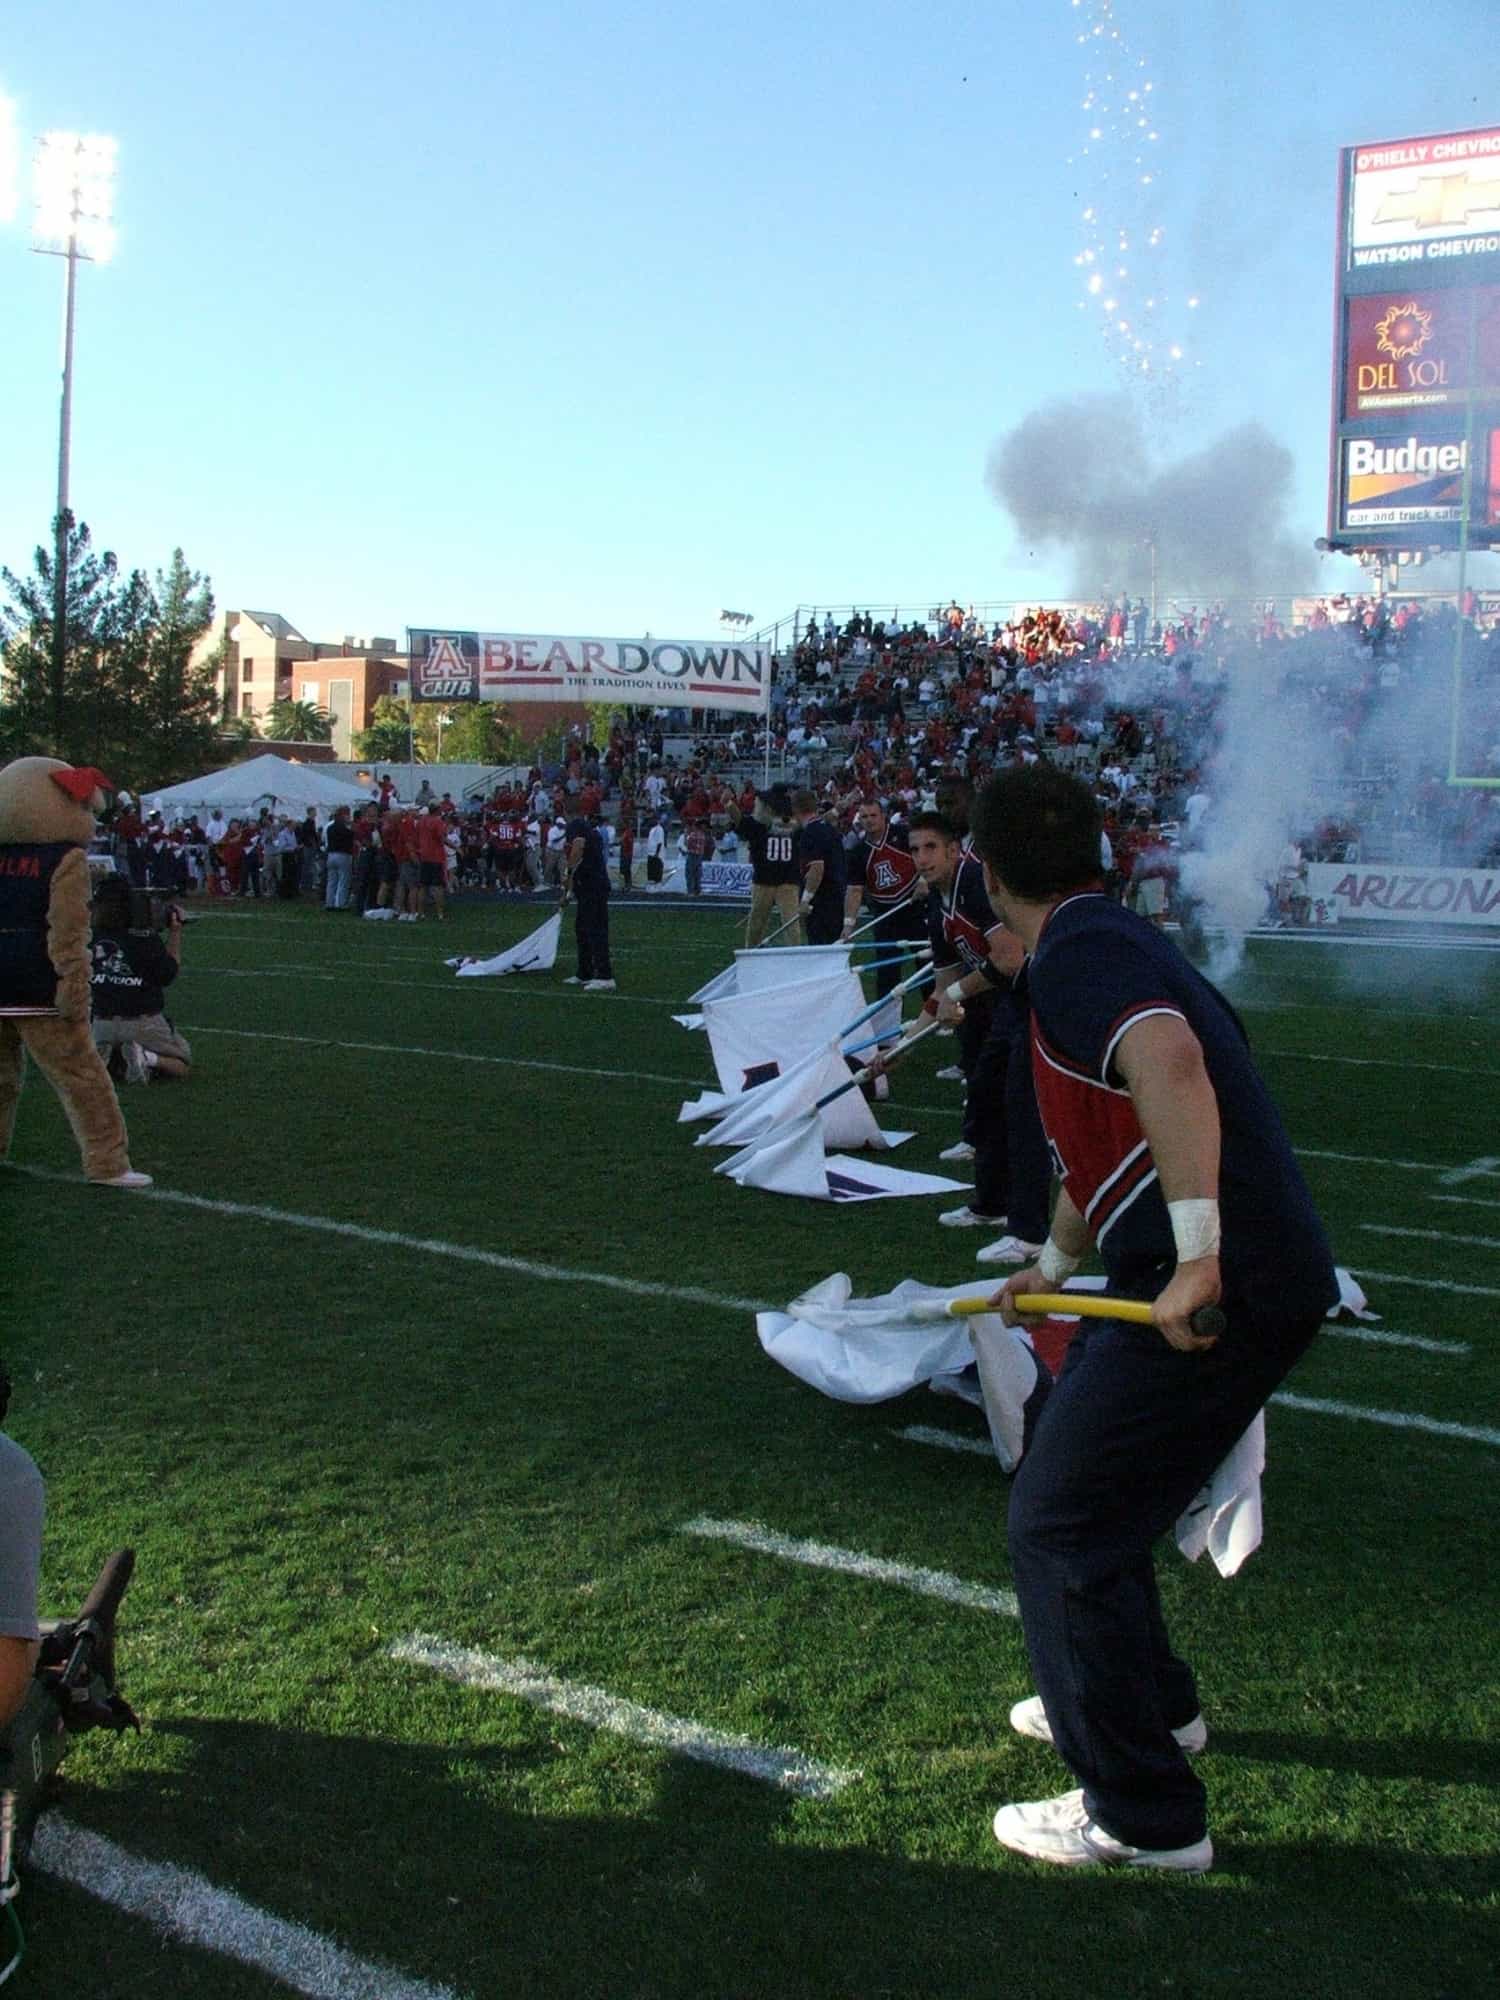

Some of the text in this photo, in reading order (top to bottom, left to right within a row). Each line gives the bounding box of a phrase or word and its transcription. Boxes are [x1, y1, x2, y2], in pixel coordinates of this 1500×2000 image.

[1357, 147, 1429, 169] O'RIELLY
[1354, 244, 1423, 266] WATSON
[1357, 359, 1449, 391] DEL SOL
[1350, 507, 1463, 523] car and truck sale
[420, 634, 472, 681] A
[567, 677, 687, 691] THE TRADITION LIVES
[766, 836, 793, 862] 00
[874, 859, 902, 890] A
